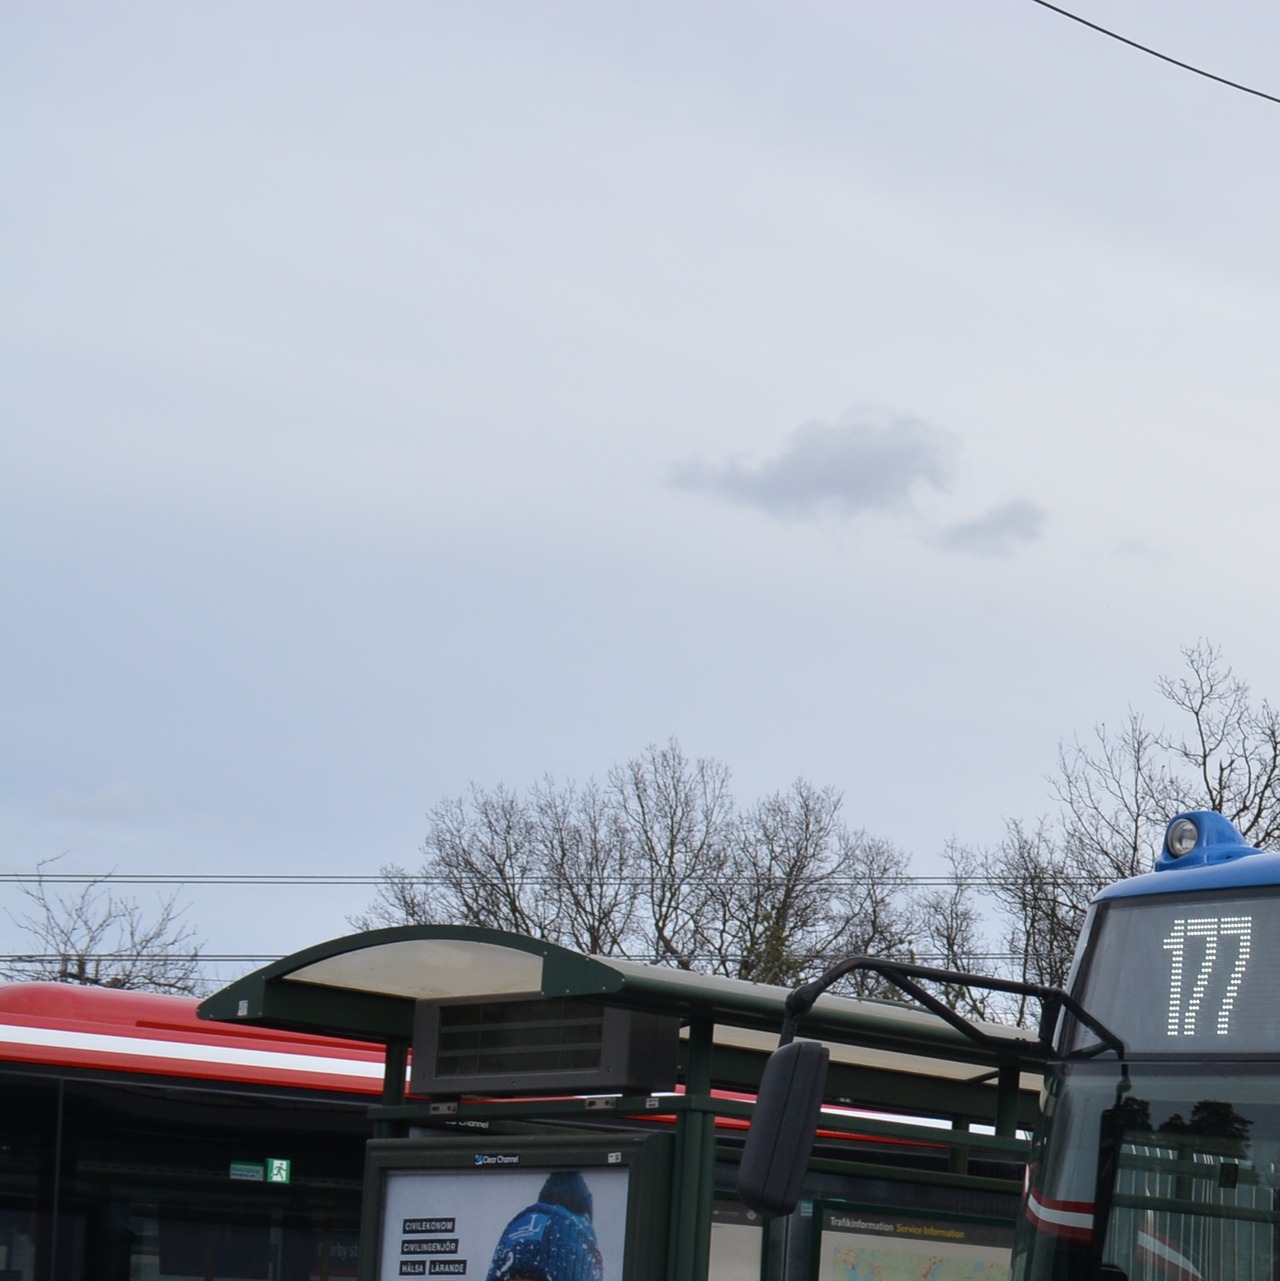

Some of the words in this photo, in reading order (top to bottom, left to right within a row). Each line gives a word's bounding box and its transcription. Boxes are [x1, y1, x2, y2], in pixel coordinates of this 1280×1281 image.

[1162, 915, 1254, 1037] 177
[404, 1221, 453, 1231] CIVILEKONOM
[829, 1216, 894, 1233] Trafikinformation
[895, 1223, 922, 1235] Service
[923, 1226, 965, 1240] Information
[402, 1241, 456, 1252] CIVILINGENJÖR
[401, 1262, 424, 1273] HÄLSA
[430, 1262, 465, 1273] LÄRANDE
